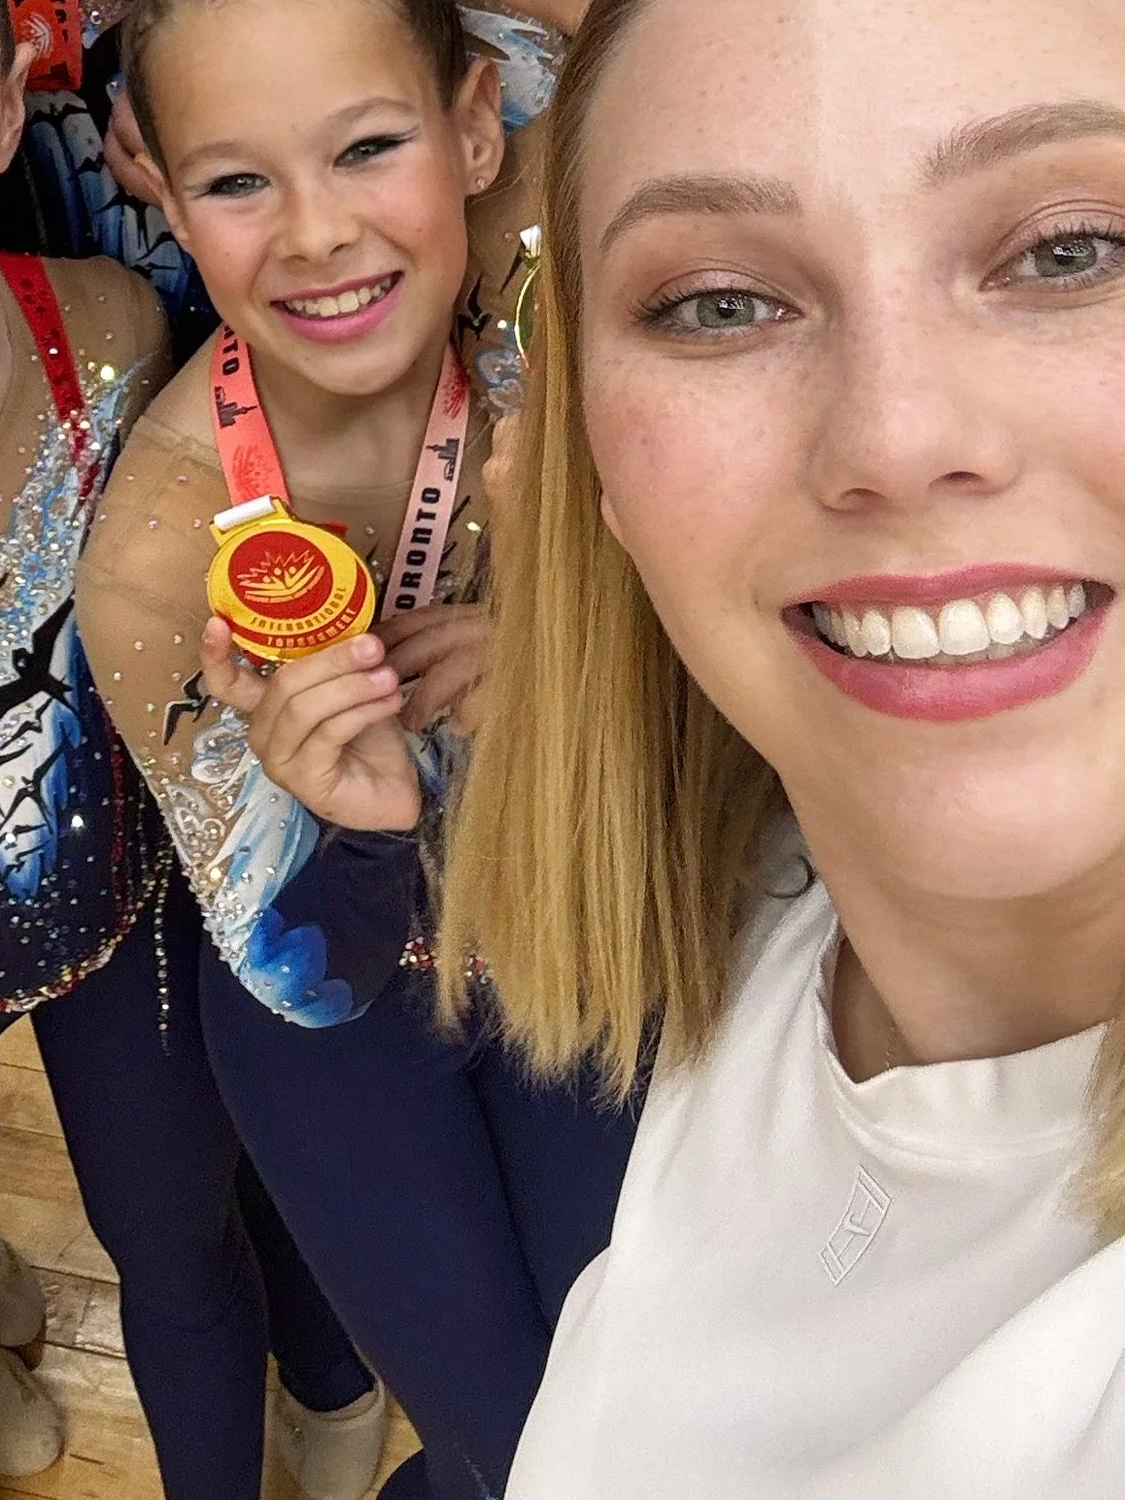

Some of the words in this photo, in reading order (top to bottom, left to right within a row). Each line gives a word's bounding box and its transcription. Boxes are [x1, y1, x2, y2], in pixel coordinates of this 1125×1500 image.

[394, 486, 441, 610] ORONTO
[250, 586, 347, 632] INTERNATIONAL
[267, 607, 357, 647] TOURNAMENT
